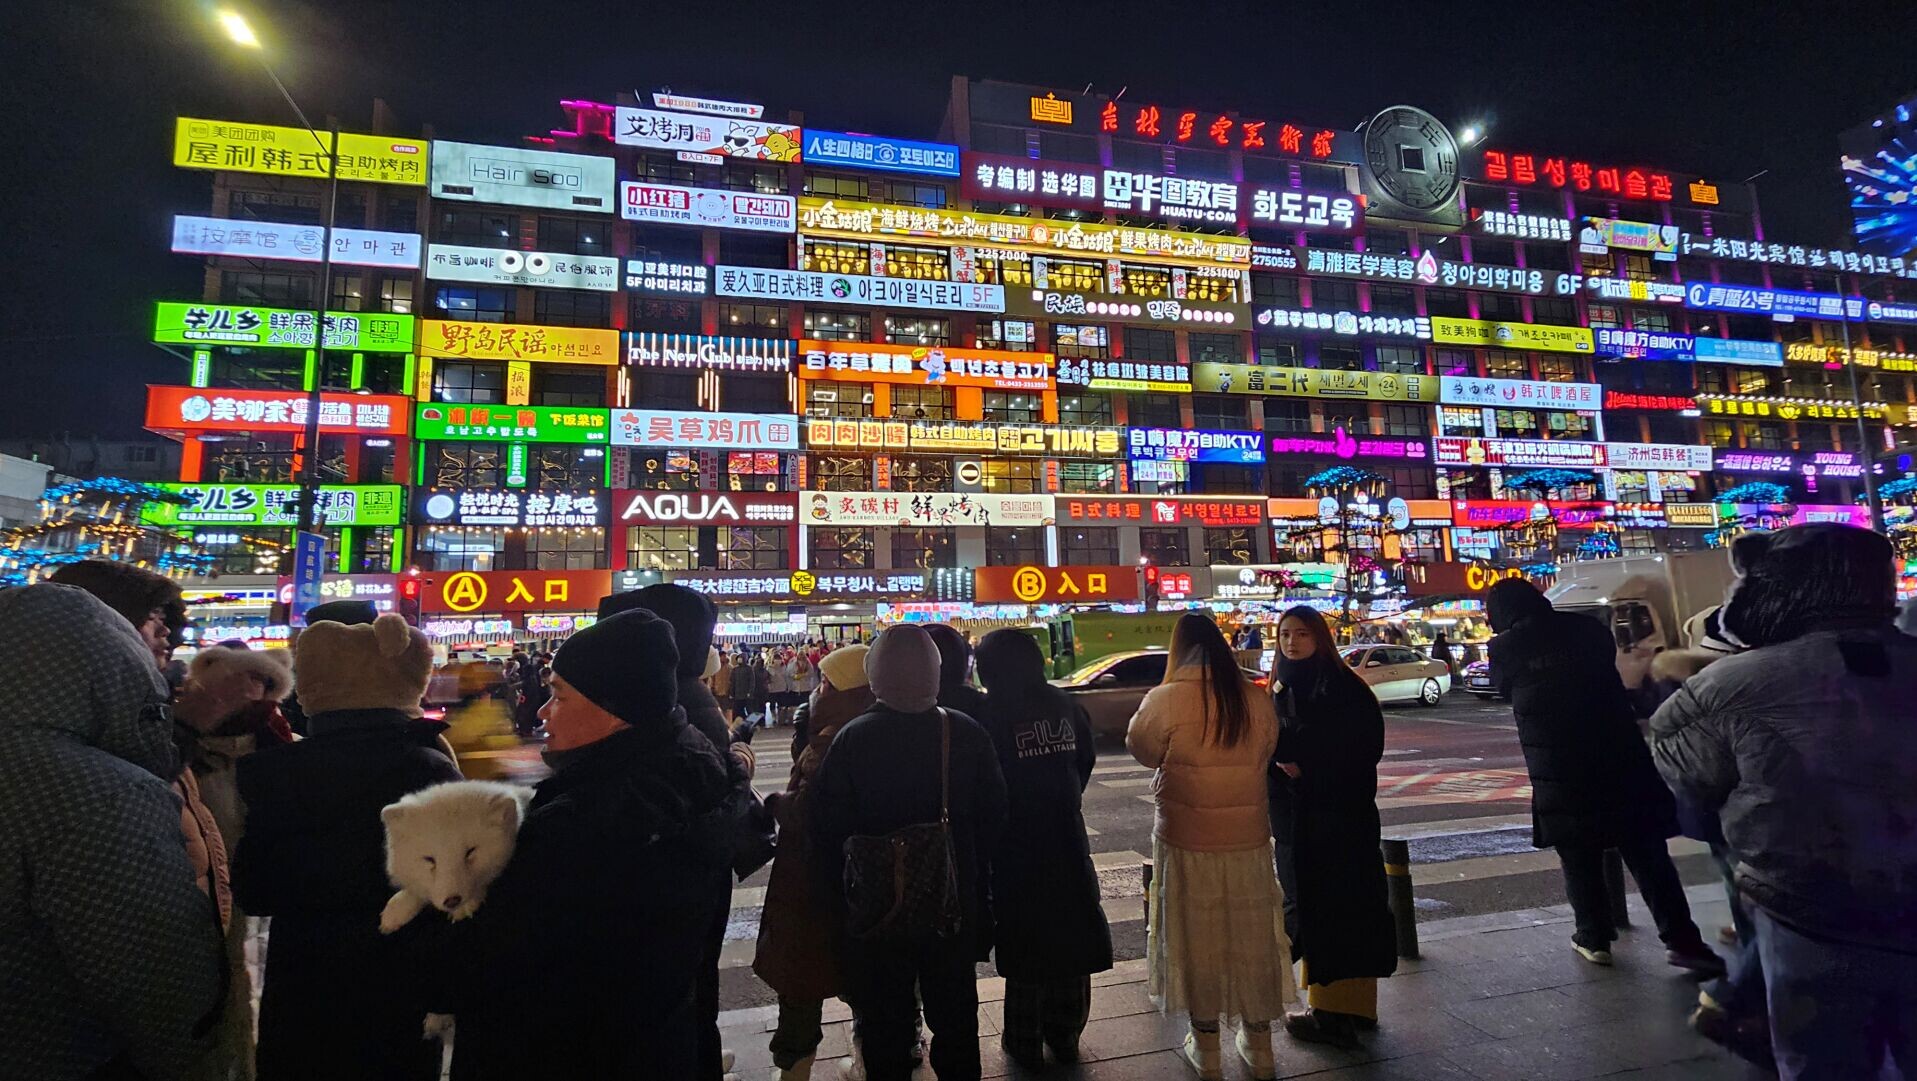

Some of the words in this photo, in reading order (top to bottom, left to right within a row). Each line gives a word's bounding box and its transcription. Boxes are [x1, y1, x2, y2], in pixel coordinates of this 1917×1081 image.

[213, 126, 275, 142] 美团团购
[622, 116, 694, 142] 艾烤洞
[186, 141, 332, 175] 屋利韩式
[336, 154, 419, 173] 自助烤肉
[473, 163, 524, 182] Hair
[534, 169, 579, 188] Soo
[976, 164, 1035, 191] 考编制
[1042, 171, 1096, 198] 选华图
[631, 188, 687, 209] 小红猪
[1132, 174, 1238, 211] 华图教育
[628, 207, 690, 220] 韩式自助烤肉
[735, 197, 788, 217] 빨간돼지
[803, 201, 873, 233] 小金姑娘
[881, 207, 940, 232] 海鲜烧烤
[1254, 190, 1354, 228] 화도교육
[200, 225, 280, 249] 按摩馆
[335, 238, 406, 257] 안마관
[1053, 223, 1115, 253] 小金姑娘
[1120, 231, 1173, 252] 鲜果烤肉
[977, 246, 1028, 262] 2252000
[1252, 254, 1297, 269] 2750555
[1691, 237, 1807, 267] 一米阳光宾馆
[626, 276, 644, 288] 5F
[644, 277, 706, 294] 아미리치과
[722, 269, 824, 299] 爱久亚日式料理
[1442, 261, 1544, 294] 청아의학미용
[1556, 273, 1584, 296] 6F
[858, 282, 963, 307] 아크아일식료리
[972, 285, 995, 303] 5F
[1045, 292, 1086, 314] 民族
[1708, 286, 1775, 311] 青蓝公考
[441, 322, 547, 358] 野岛民谣
[1440, 323, 1490, 340] 致美狗咖
[1599, 329, 1694, 351] 自嗨魔方自助KTV
[551, 343, 603, 358] 야섬민요
[630, 345, 660, 362] The
[665, 348, 697, 363] New
[1248, 371, 1309, 393] 富二代
[1383, 380, 1395, 390] 24
[1520, 383, 1592, 401] 韩式啤酒屋
[211, 396, 290, 423] 美娜家
[550, 413, 605, 428] 下饭菜馆
[648, 416, 763, 444] 吴草鸡爪
[810, 424, 907, 446] 肉肉沙隆
[910, 425, 996, 440] 韩式自助烤肉
[1130, 429, 1261, 449] 自嗨魔方自助KTV
[1131, 447, 1199, 459] 루빅큐브무인
[1628, 446, 1687, 462] 济州岛韩餐
[1814, 452, 1853, 465] YOUNG
[264, 490, 356, 508] 鲜肉
[525, 493, 598, 515] 按摩吧
[621, 495, 740, 520] AQUA
[1069, 502, 1142, 518] 日式料理
[262, 508, 356, 523] 소아고기
[816, 576, 874, 594] 복무청사
[879, 575, 924, 592] 길랭면
[1021, 572, 1039, 596] B
[1057, 571, 1107, 595] 入口
[1466, 566, 1485, 590] C
[452, 576, 479, 603] A
[505, 577, 568, 603] 入口
[1016, 718, 1076, 750] FILA
